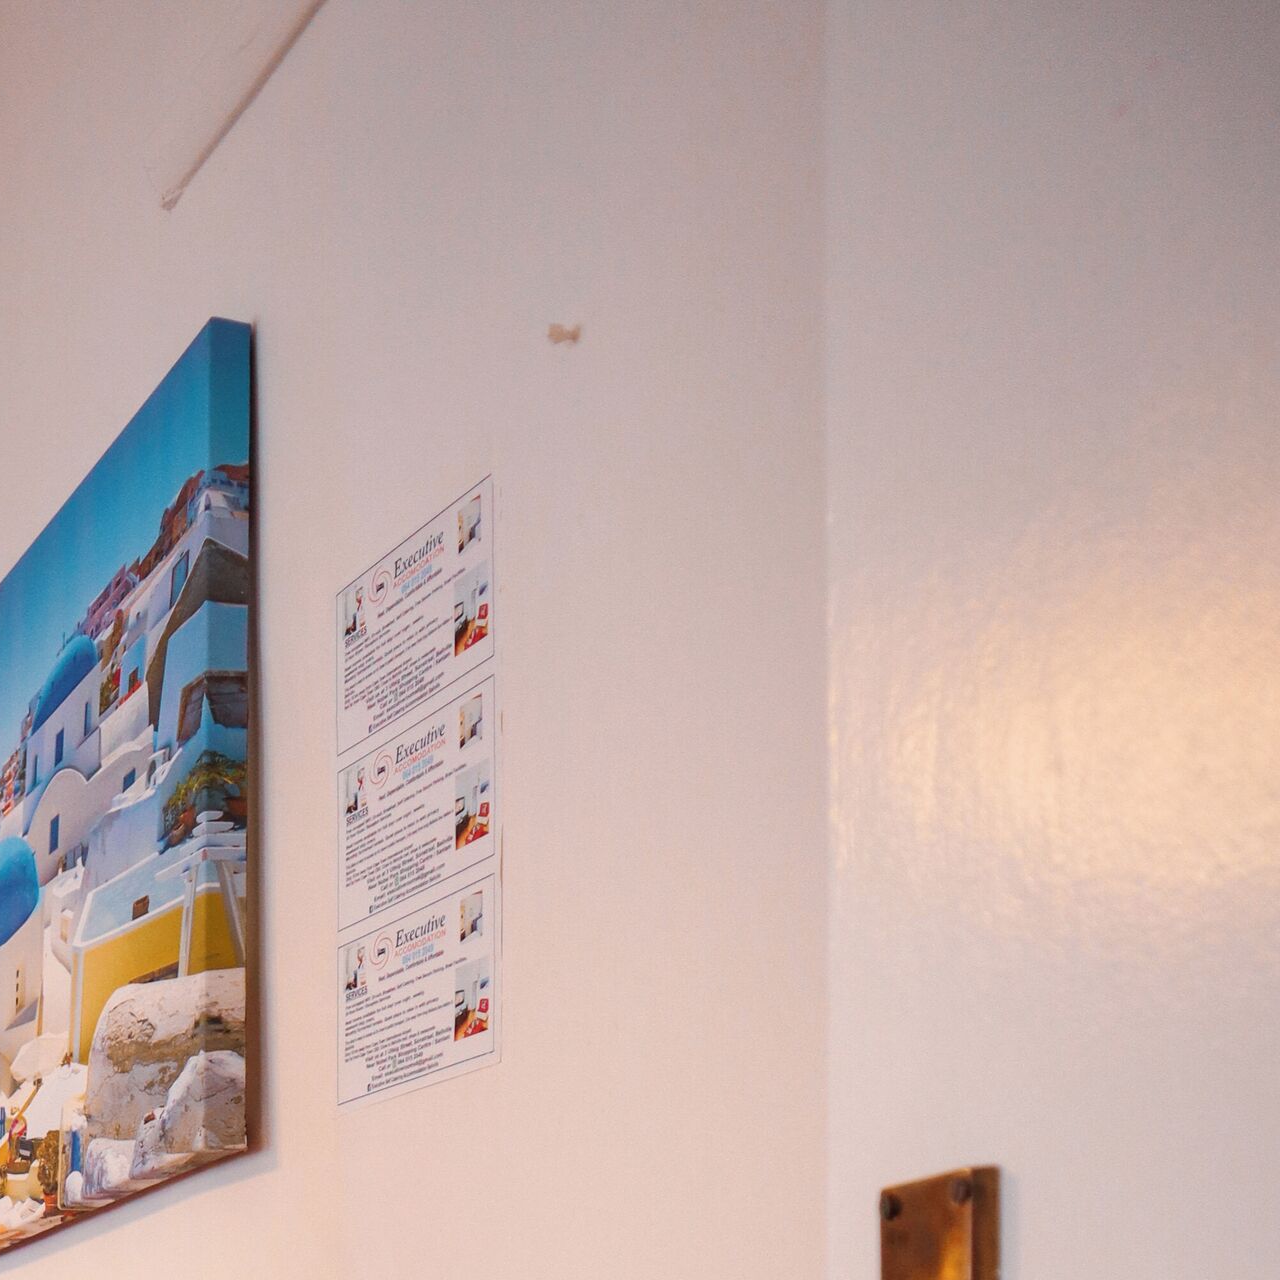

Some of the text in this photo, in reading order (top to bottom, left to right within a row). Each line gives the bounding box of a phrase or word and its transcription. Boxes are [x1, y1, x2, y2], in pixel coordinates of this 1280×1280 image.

[394, 531, 444, 579] Executive
[345, 626, 367, 648] SERVICES
[395, 724, 445, 764] Executive
[346, 807, 368, 827] SERVICES
[395, 914, 446, 948] Executive
[345, 986, 368, 1001] SERVICES
